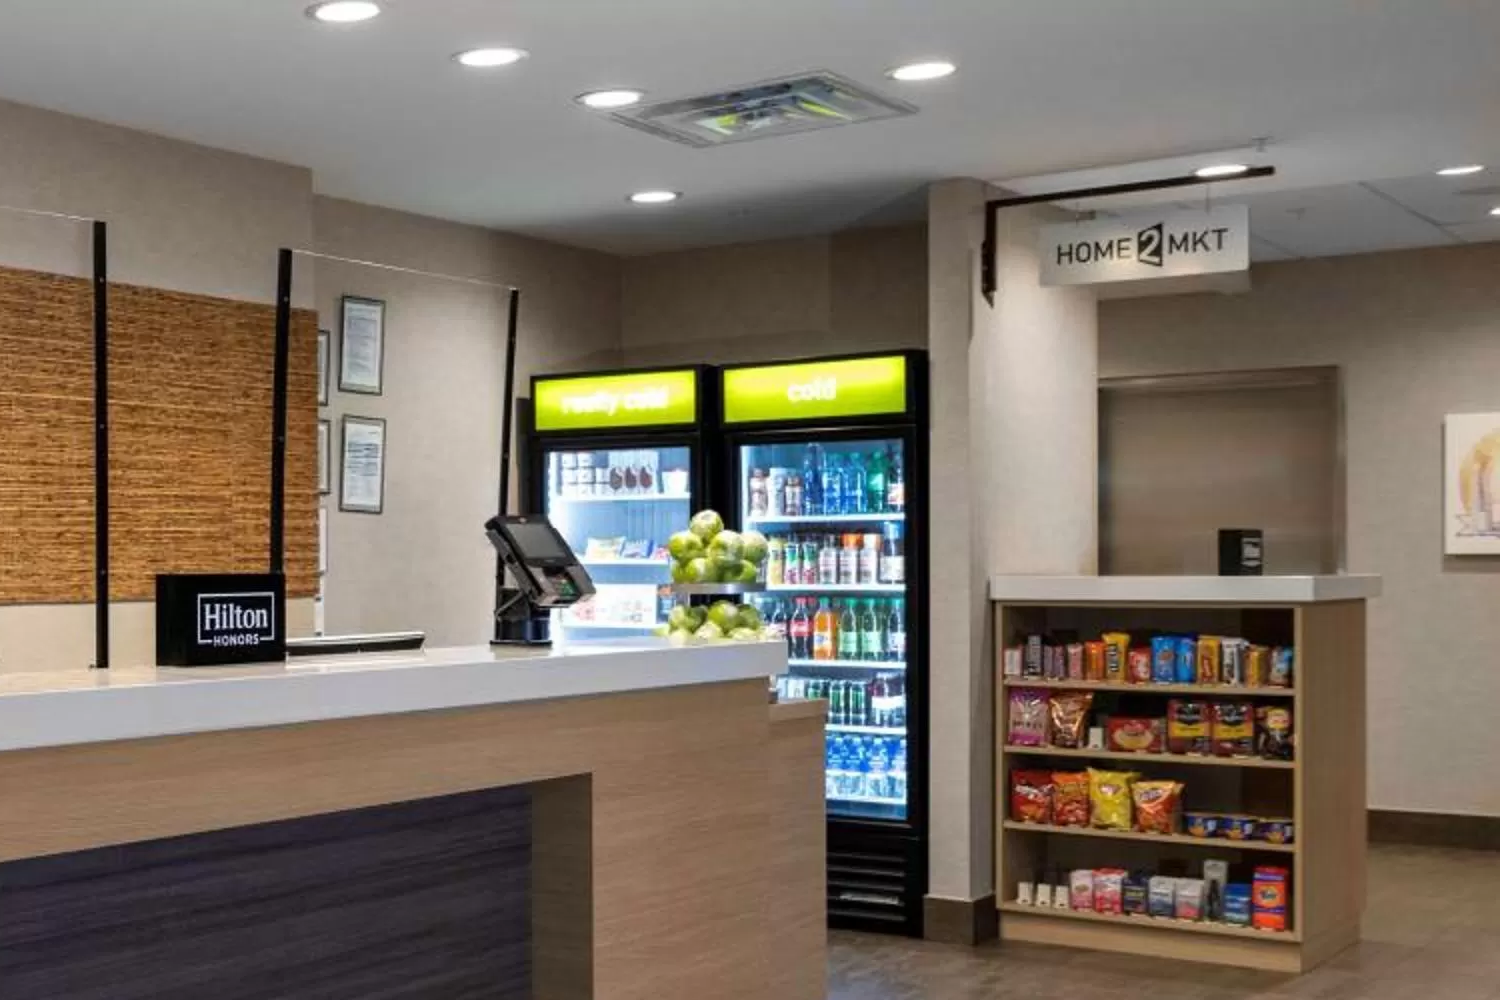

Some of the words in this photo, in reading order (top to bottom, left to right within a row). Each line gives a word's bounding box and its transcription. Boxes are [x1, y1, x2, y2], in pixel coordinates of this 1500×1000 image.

[1056, 237, 1133, 266] HOME
[1139, 225, 1163, 266] 2
[1168, 228, 1228, 255] MKT
[786, 377, 837, 402] cold
[203, 603, 268, 631] Hilton
[213, 633, 259, 647] HONORS
